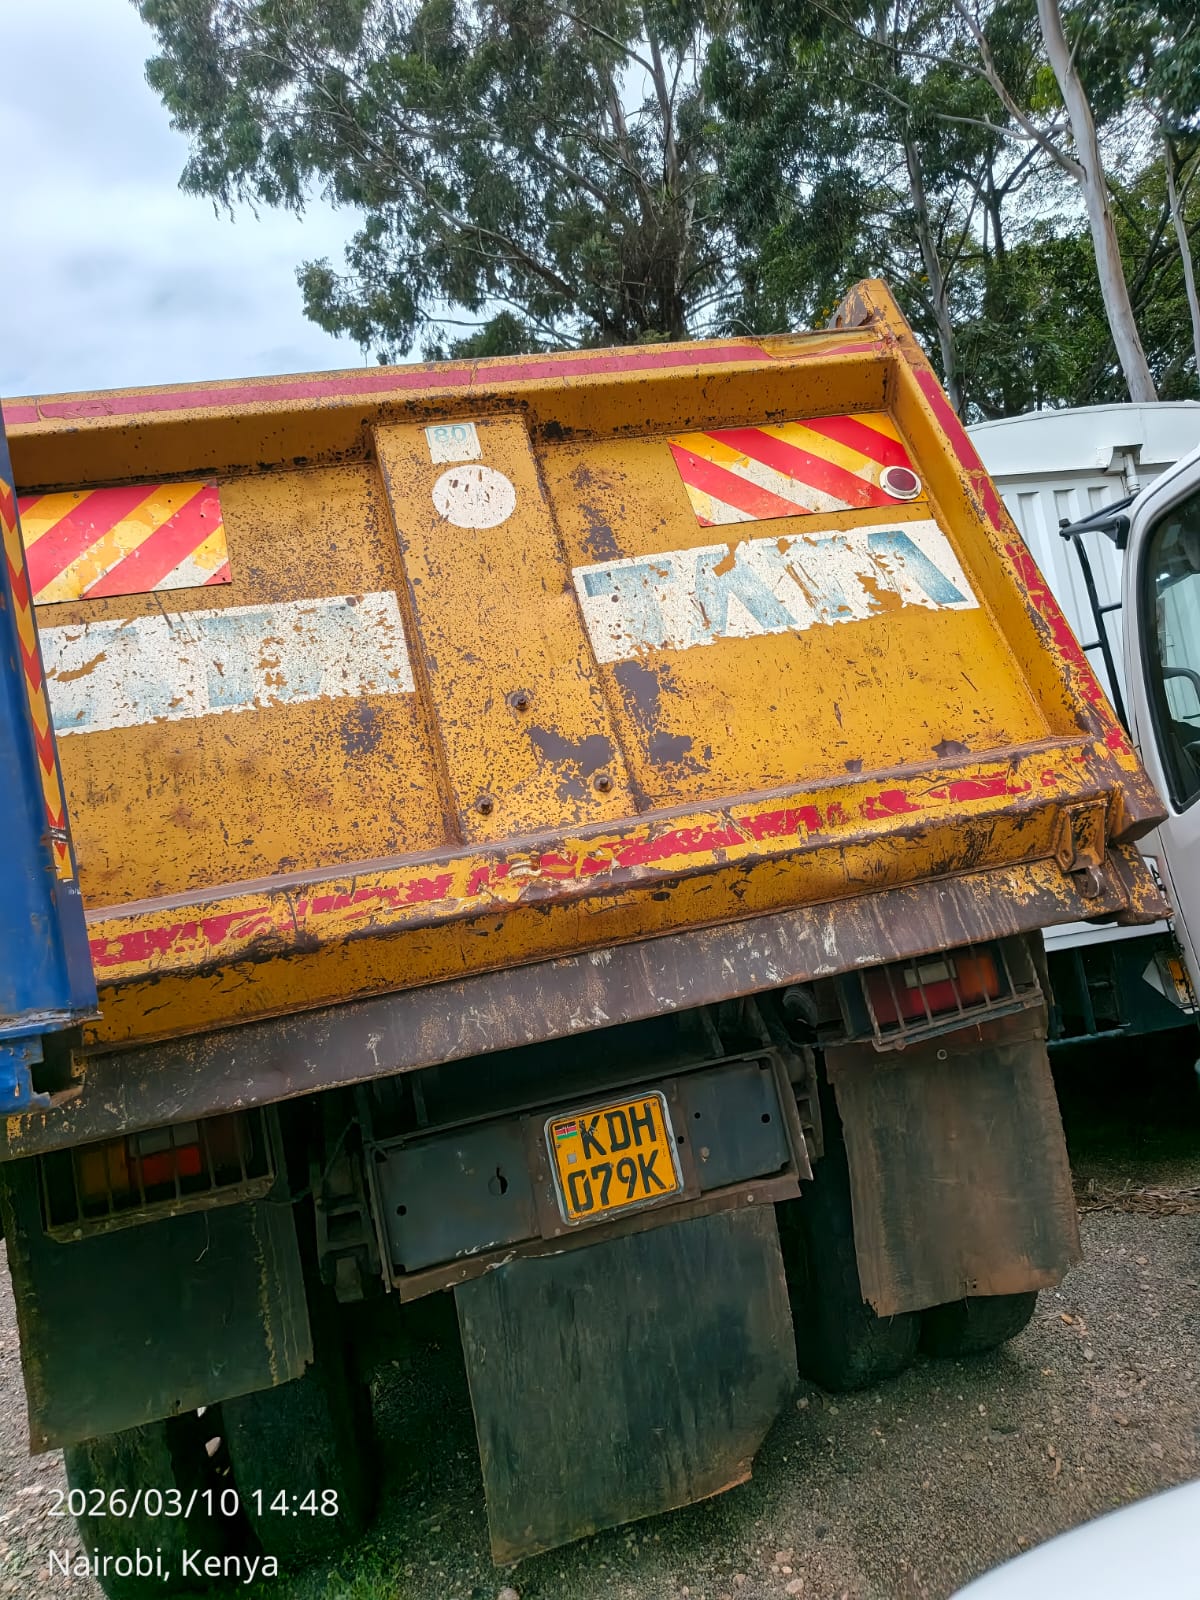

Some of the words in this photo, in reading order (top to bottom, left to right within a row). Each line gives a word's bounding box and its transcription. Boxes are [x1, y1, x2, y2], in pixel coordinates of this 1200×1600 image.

[433, 426, 467, 443] 80
[578, 1104, 657, 1160] KDH
[567, 1149, 667, 1213] 079K
